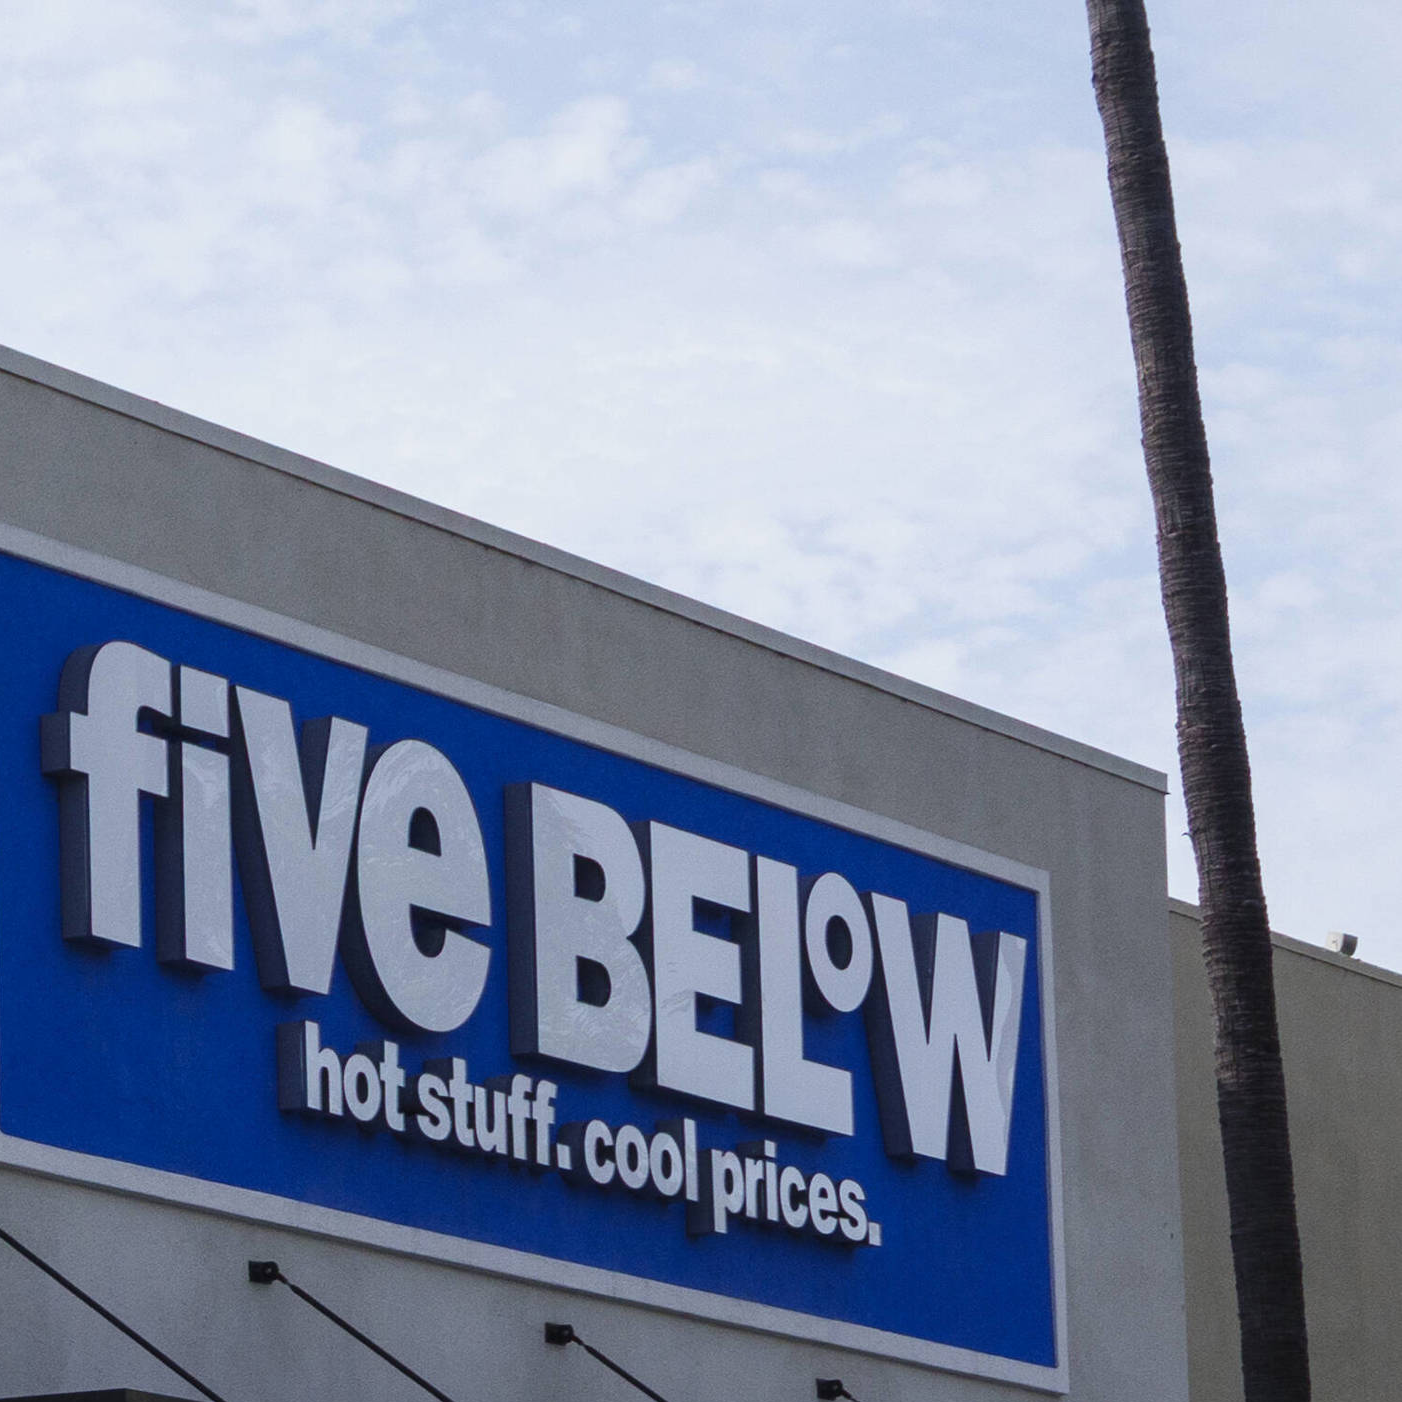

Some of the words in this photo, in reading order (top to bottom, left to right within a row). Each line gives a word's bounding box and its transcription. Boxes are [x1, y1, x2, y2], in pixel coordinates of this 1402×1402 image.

[40, 639, 492, 1034] five
[505, 781, 1027, 1177] BELOW
[288, 1021, 407, 1134] hot
[413, 1057, 572, 1173] stuff.
[580, 1118, 700, 1204] cool
[700, 1138, 883, 1249] prices.
